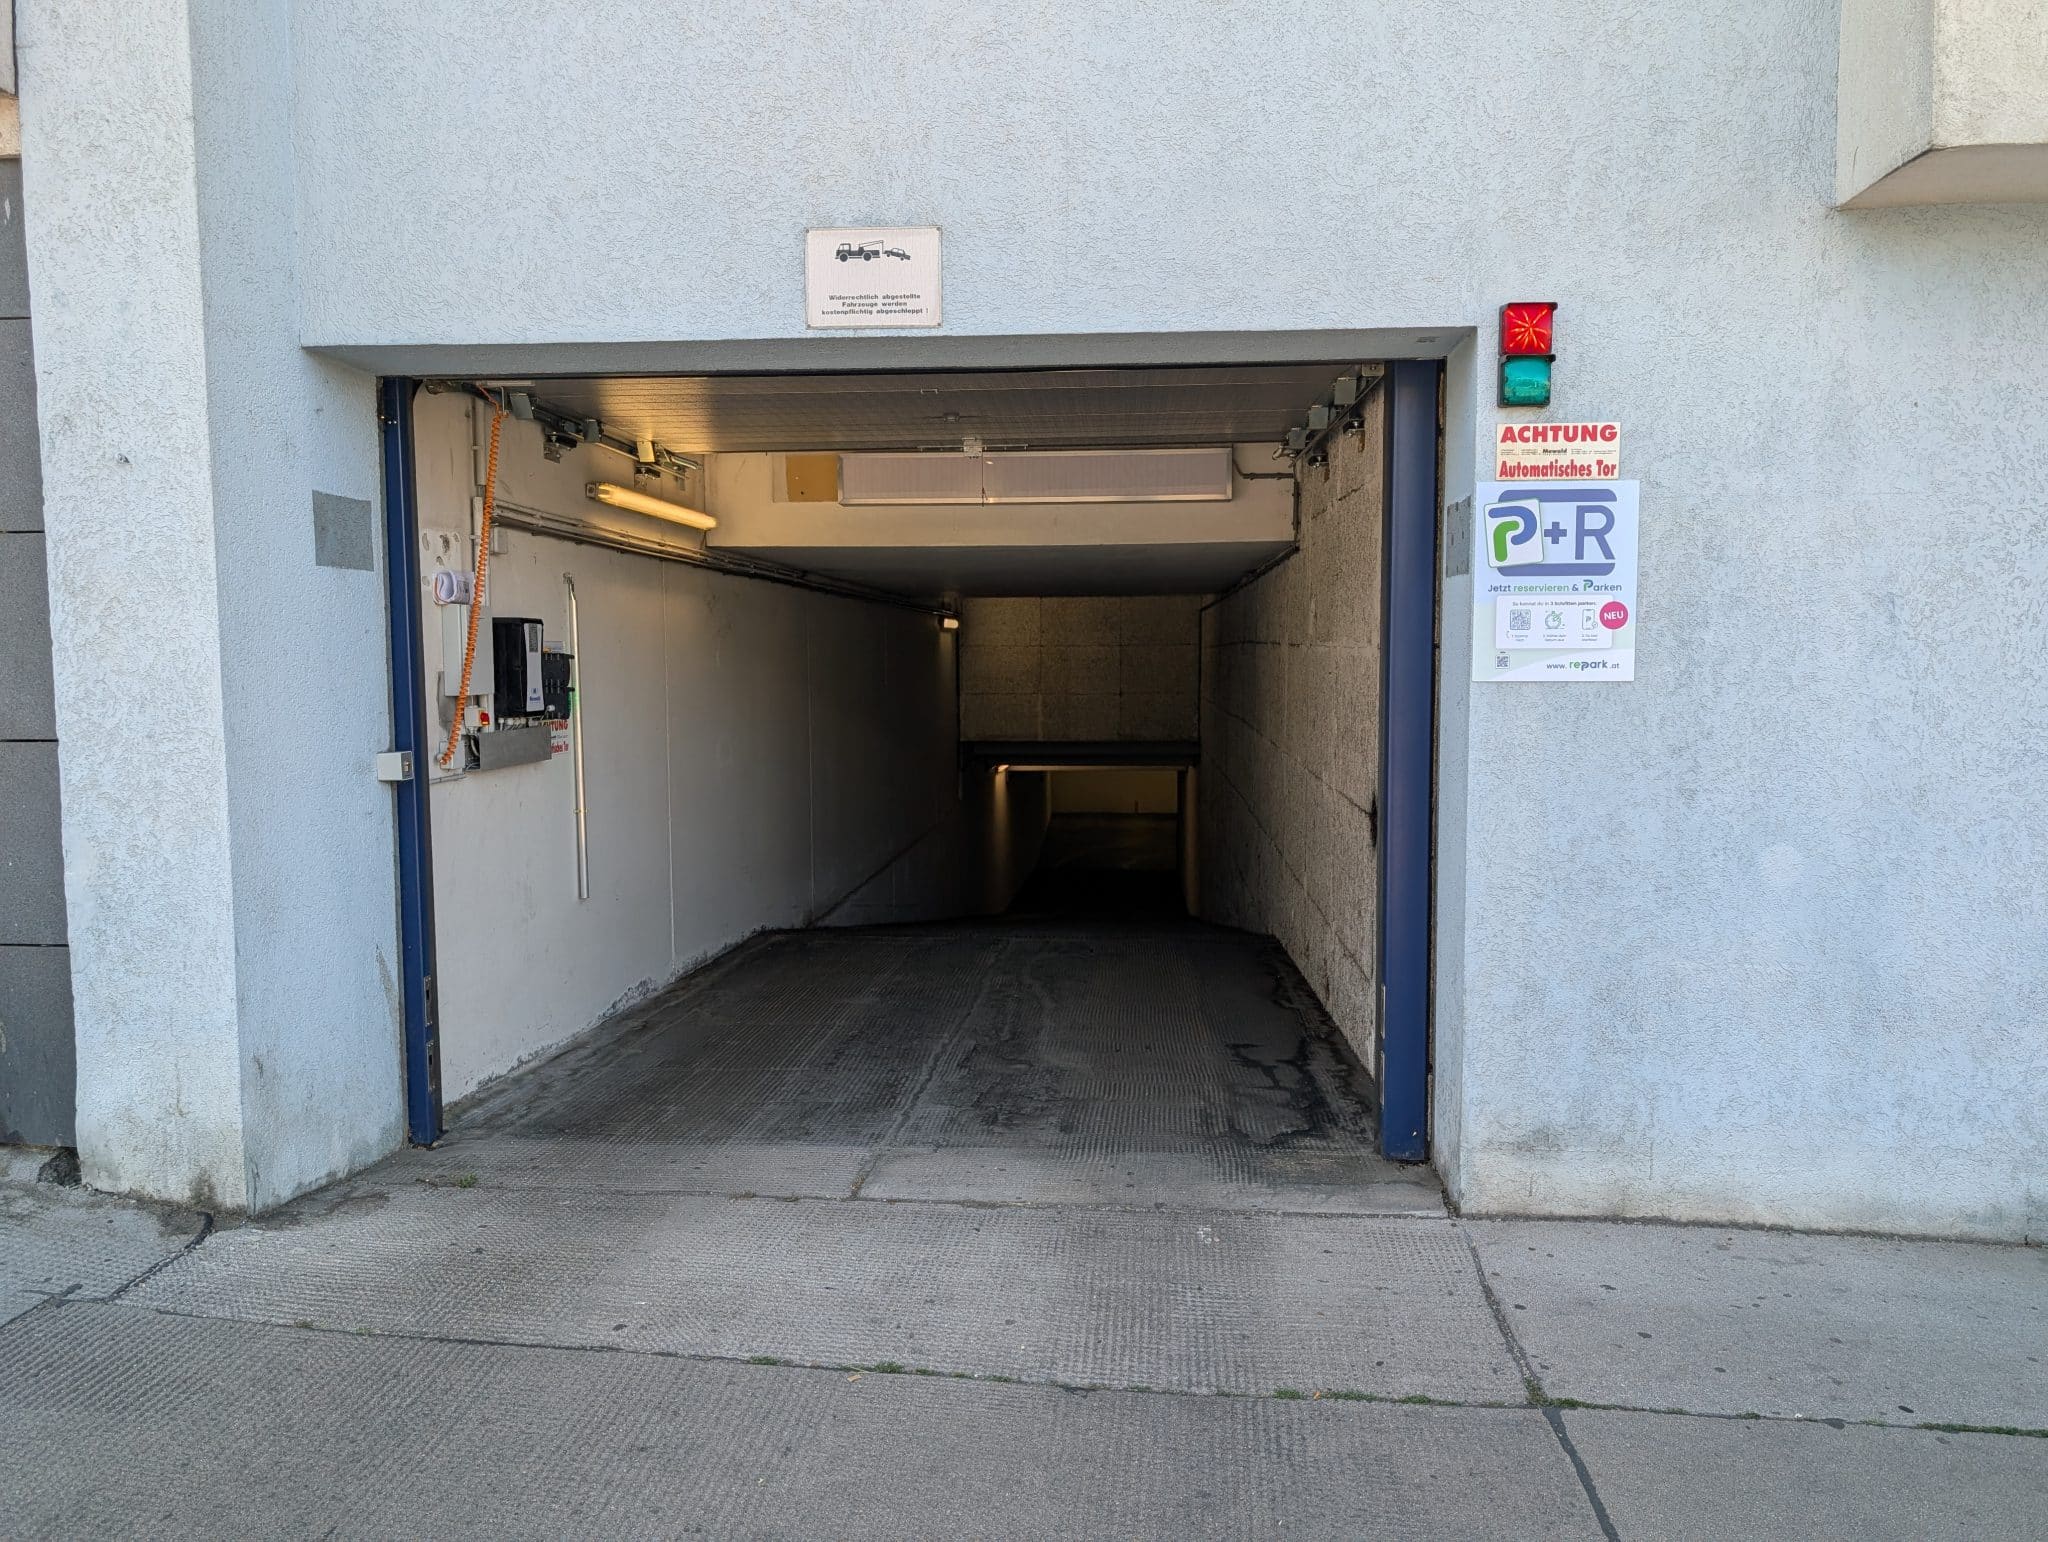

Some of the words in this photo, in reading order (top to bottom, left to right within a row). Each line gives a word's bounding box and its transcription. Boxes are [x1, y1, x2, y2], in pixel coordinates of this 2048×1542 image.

[1500, 424, 1618, 443] ACHTUNG
[1499, 458, 1593, 478] Automatisches
[1596, 459, 1617, 477] Tor
[1487, 583, 1511, 593] Jetzt
[1513, 583, 1569, 593] reservieren
[1571, 583, 1579, 592] &
[1582, 579, 1622, 592] Parken
[1603, 611, 1624, 620] NEU
